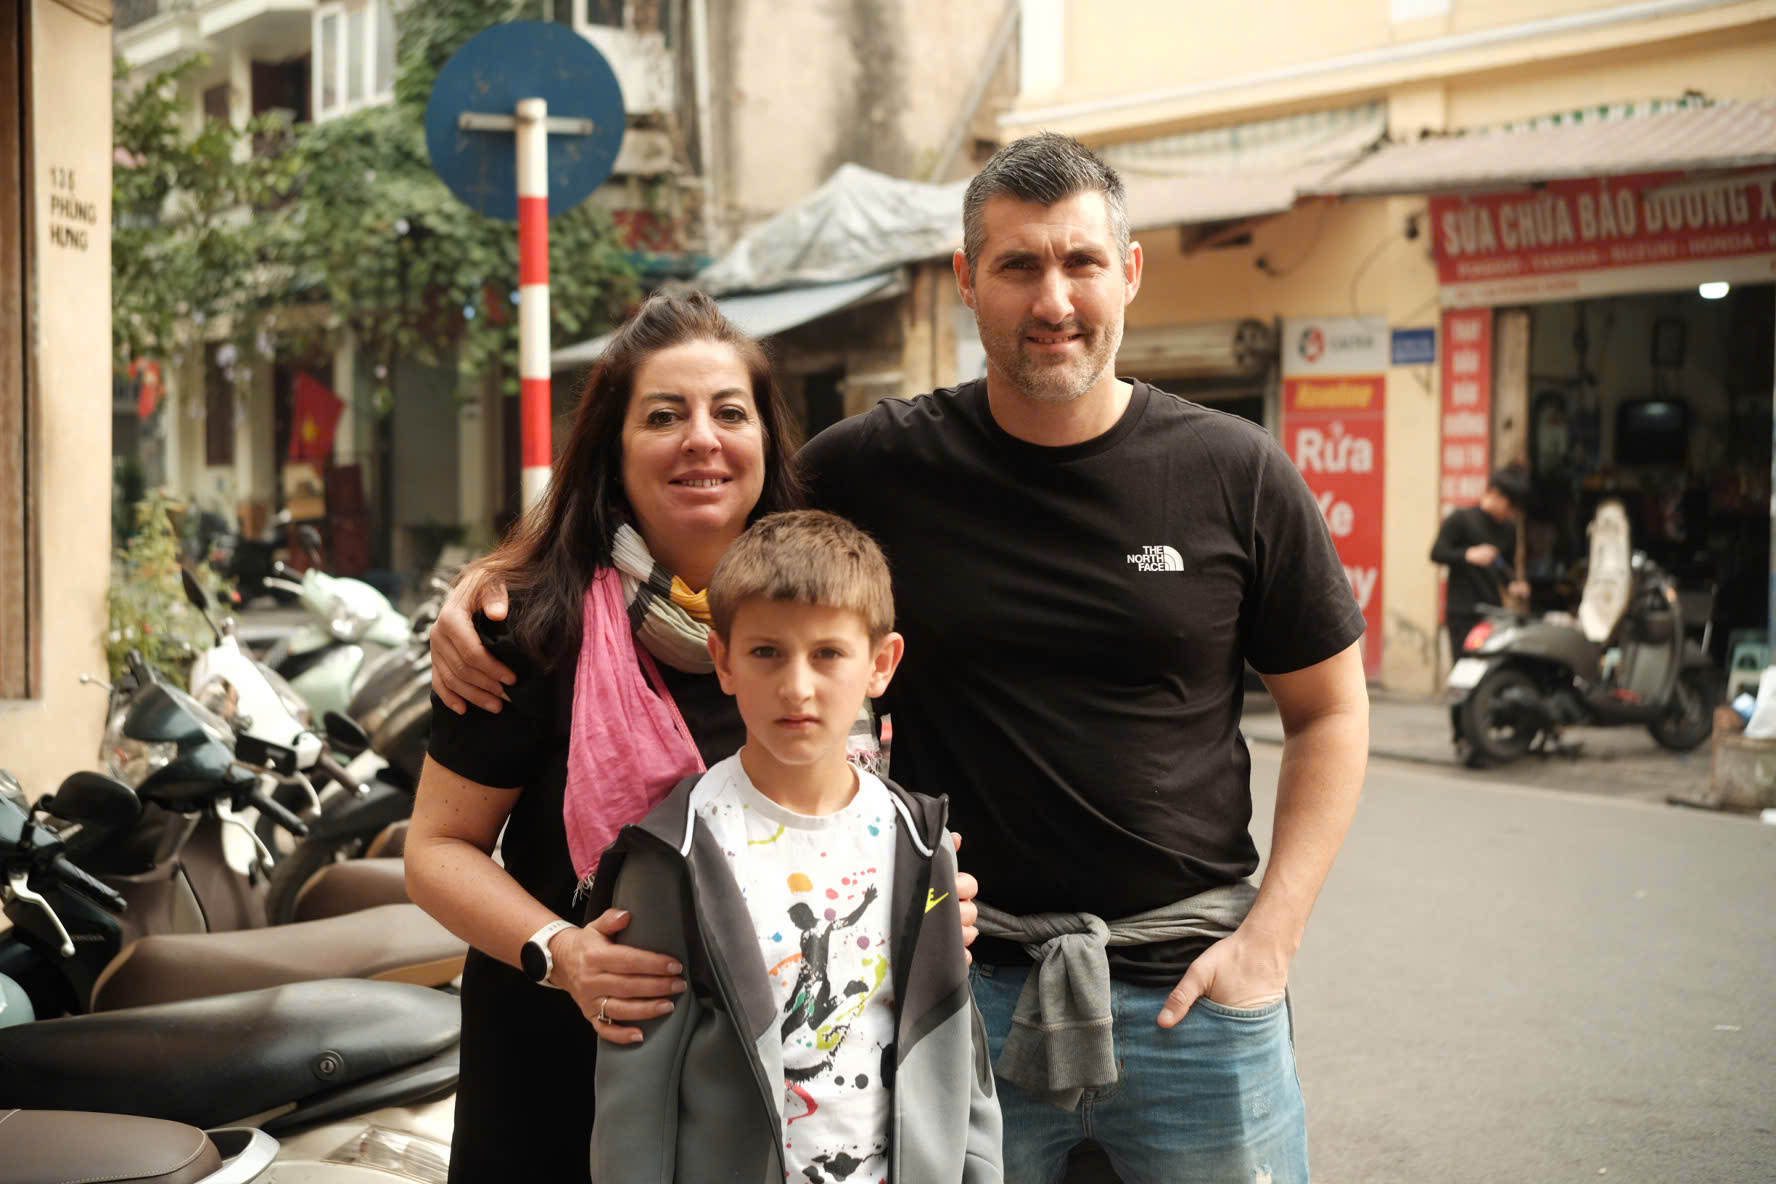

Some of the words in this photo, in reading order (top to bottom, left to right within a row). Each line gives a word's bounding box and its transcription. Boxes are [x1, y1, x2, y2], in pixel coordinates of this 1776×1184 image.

[1142, 545, 1163, 554] THE
[1126, 554, 1164, 564] NORTH
[1138, 562, 1165, 572] FACE
